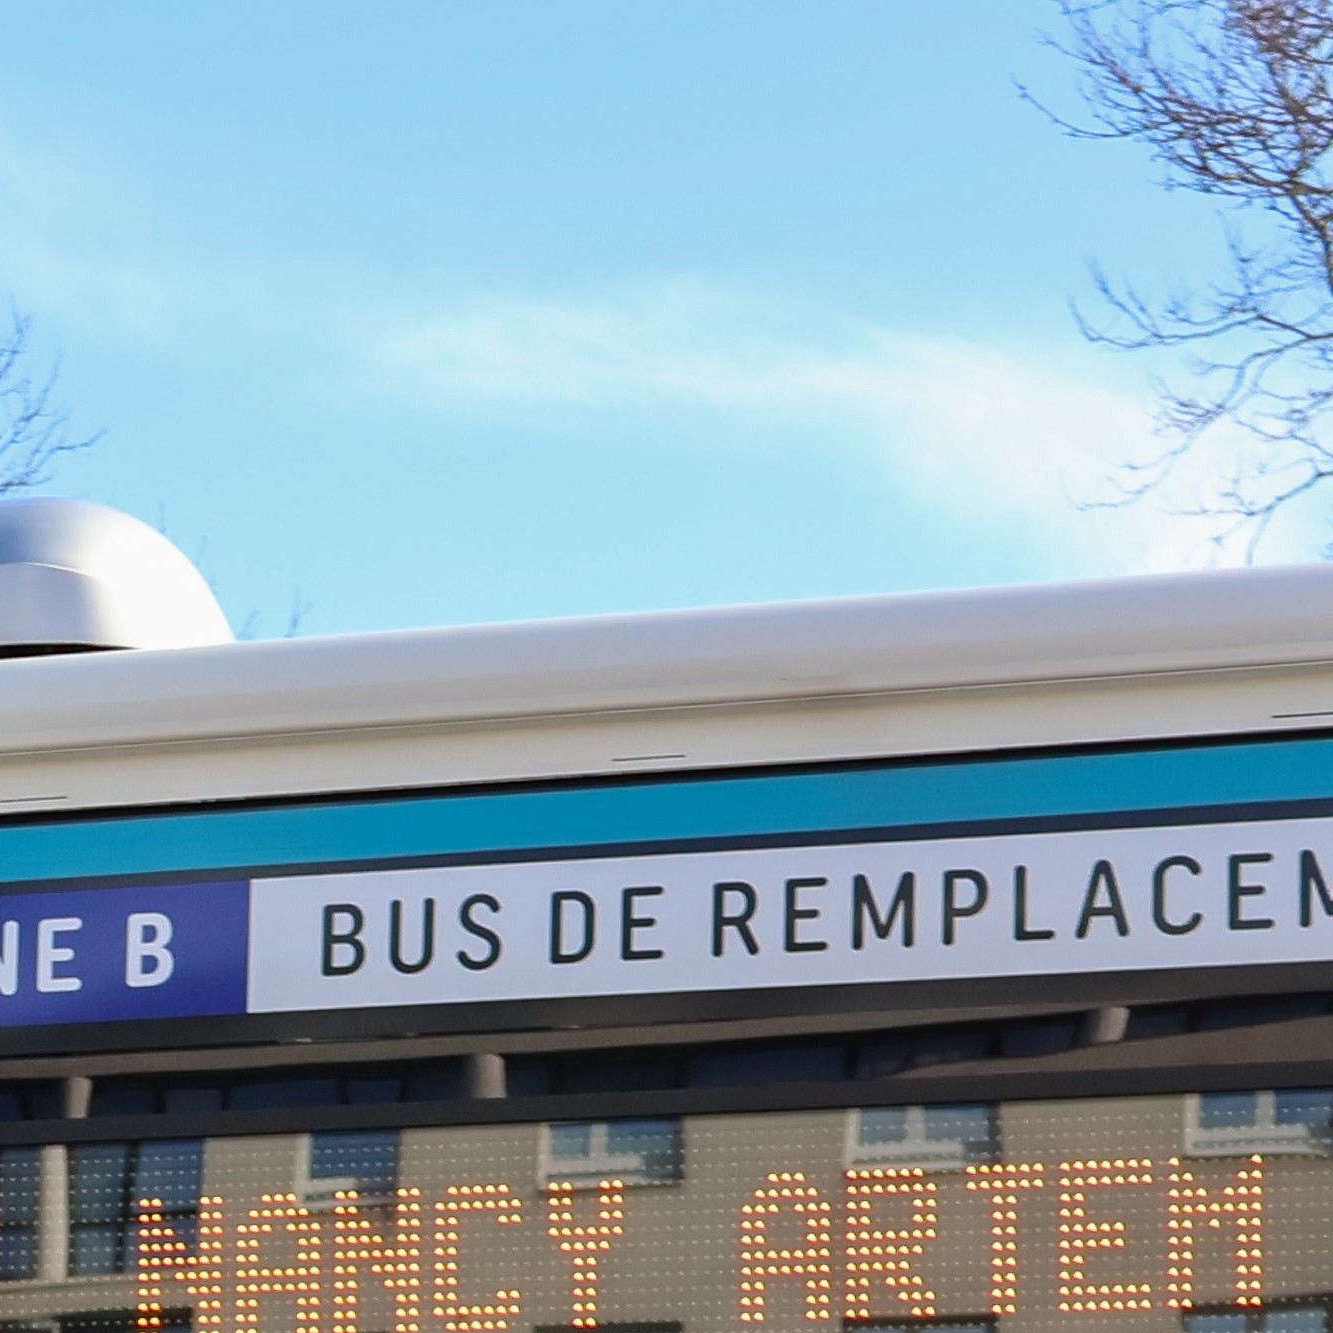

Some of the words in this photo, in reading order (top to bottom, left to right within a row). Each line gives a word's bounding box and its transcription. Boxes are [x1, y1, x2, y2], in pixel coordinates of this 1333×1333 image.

[125, 911, 176, 988] B
[320, 893, 502, 976] BUS
[549, 885, 666, 964] DE
[739, 1153, 1264, 1320] ARTEM
